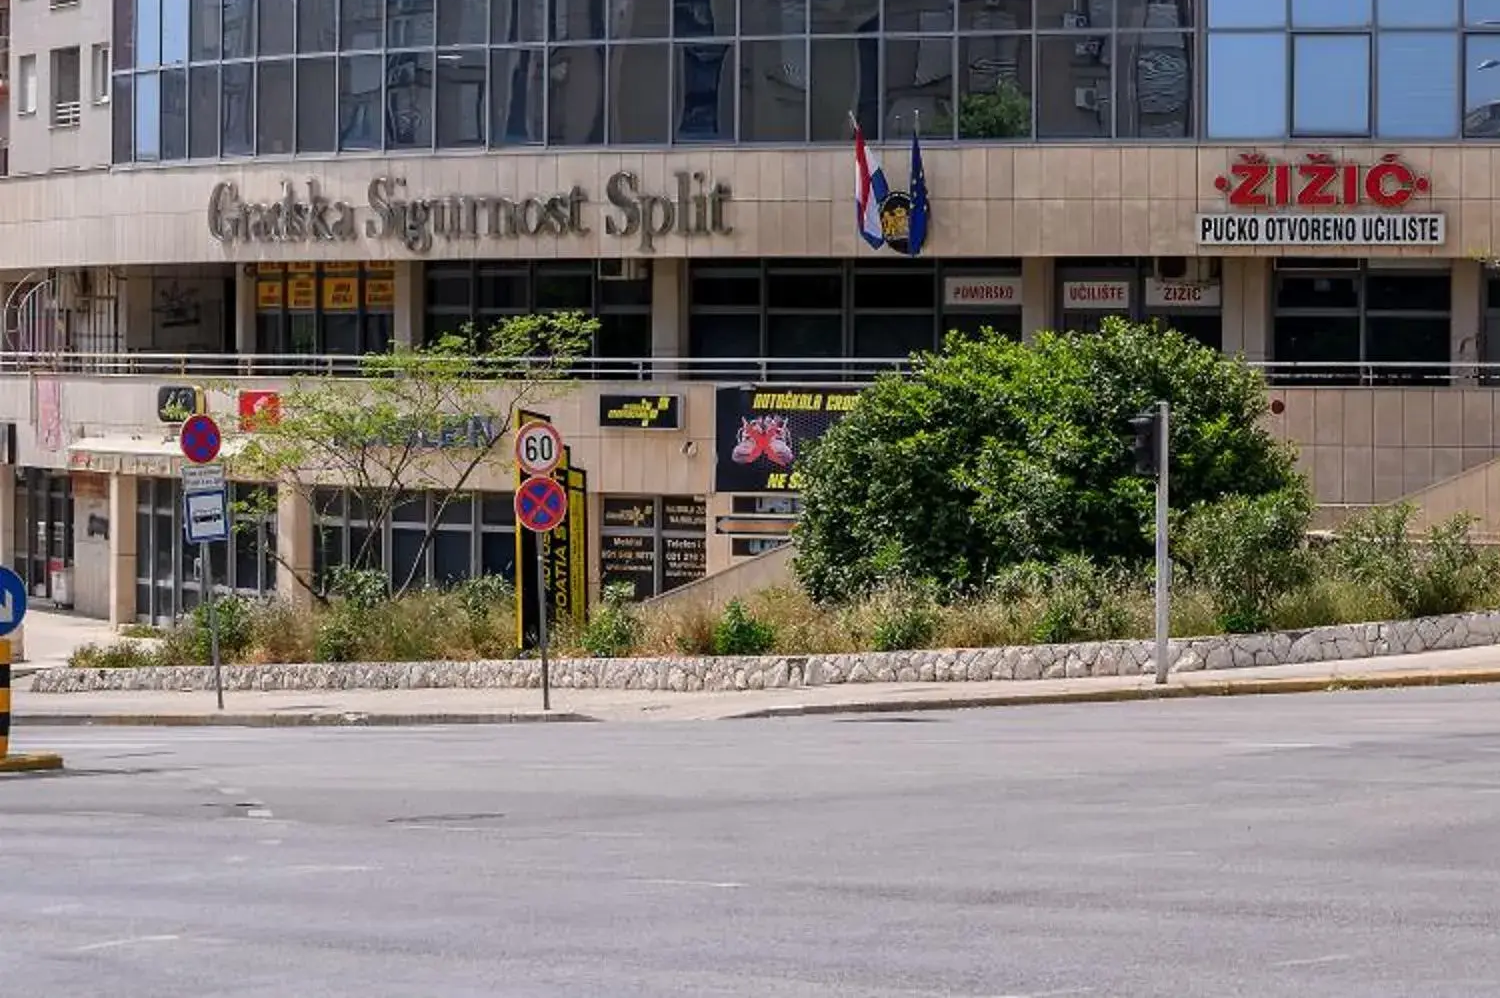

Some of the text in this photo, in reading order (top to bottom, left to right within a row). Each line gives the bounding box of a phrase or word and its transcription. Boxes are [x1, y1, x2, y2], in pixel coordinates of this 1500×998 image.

[1229, 153, 1415, 208] ŽIŽIĆ
[207, 170, 734, 254] Gradska Sigurnost Split
[1264, 217, 1356, 242] OTVORENO
[1362, 215, 1440, 242] UČILIŠTE
[1069, 282, 1126, 301] UČILIŠTE
[525, 435, 553, 461] 60
